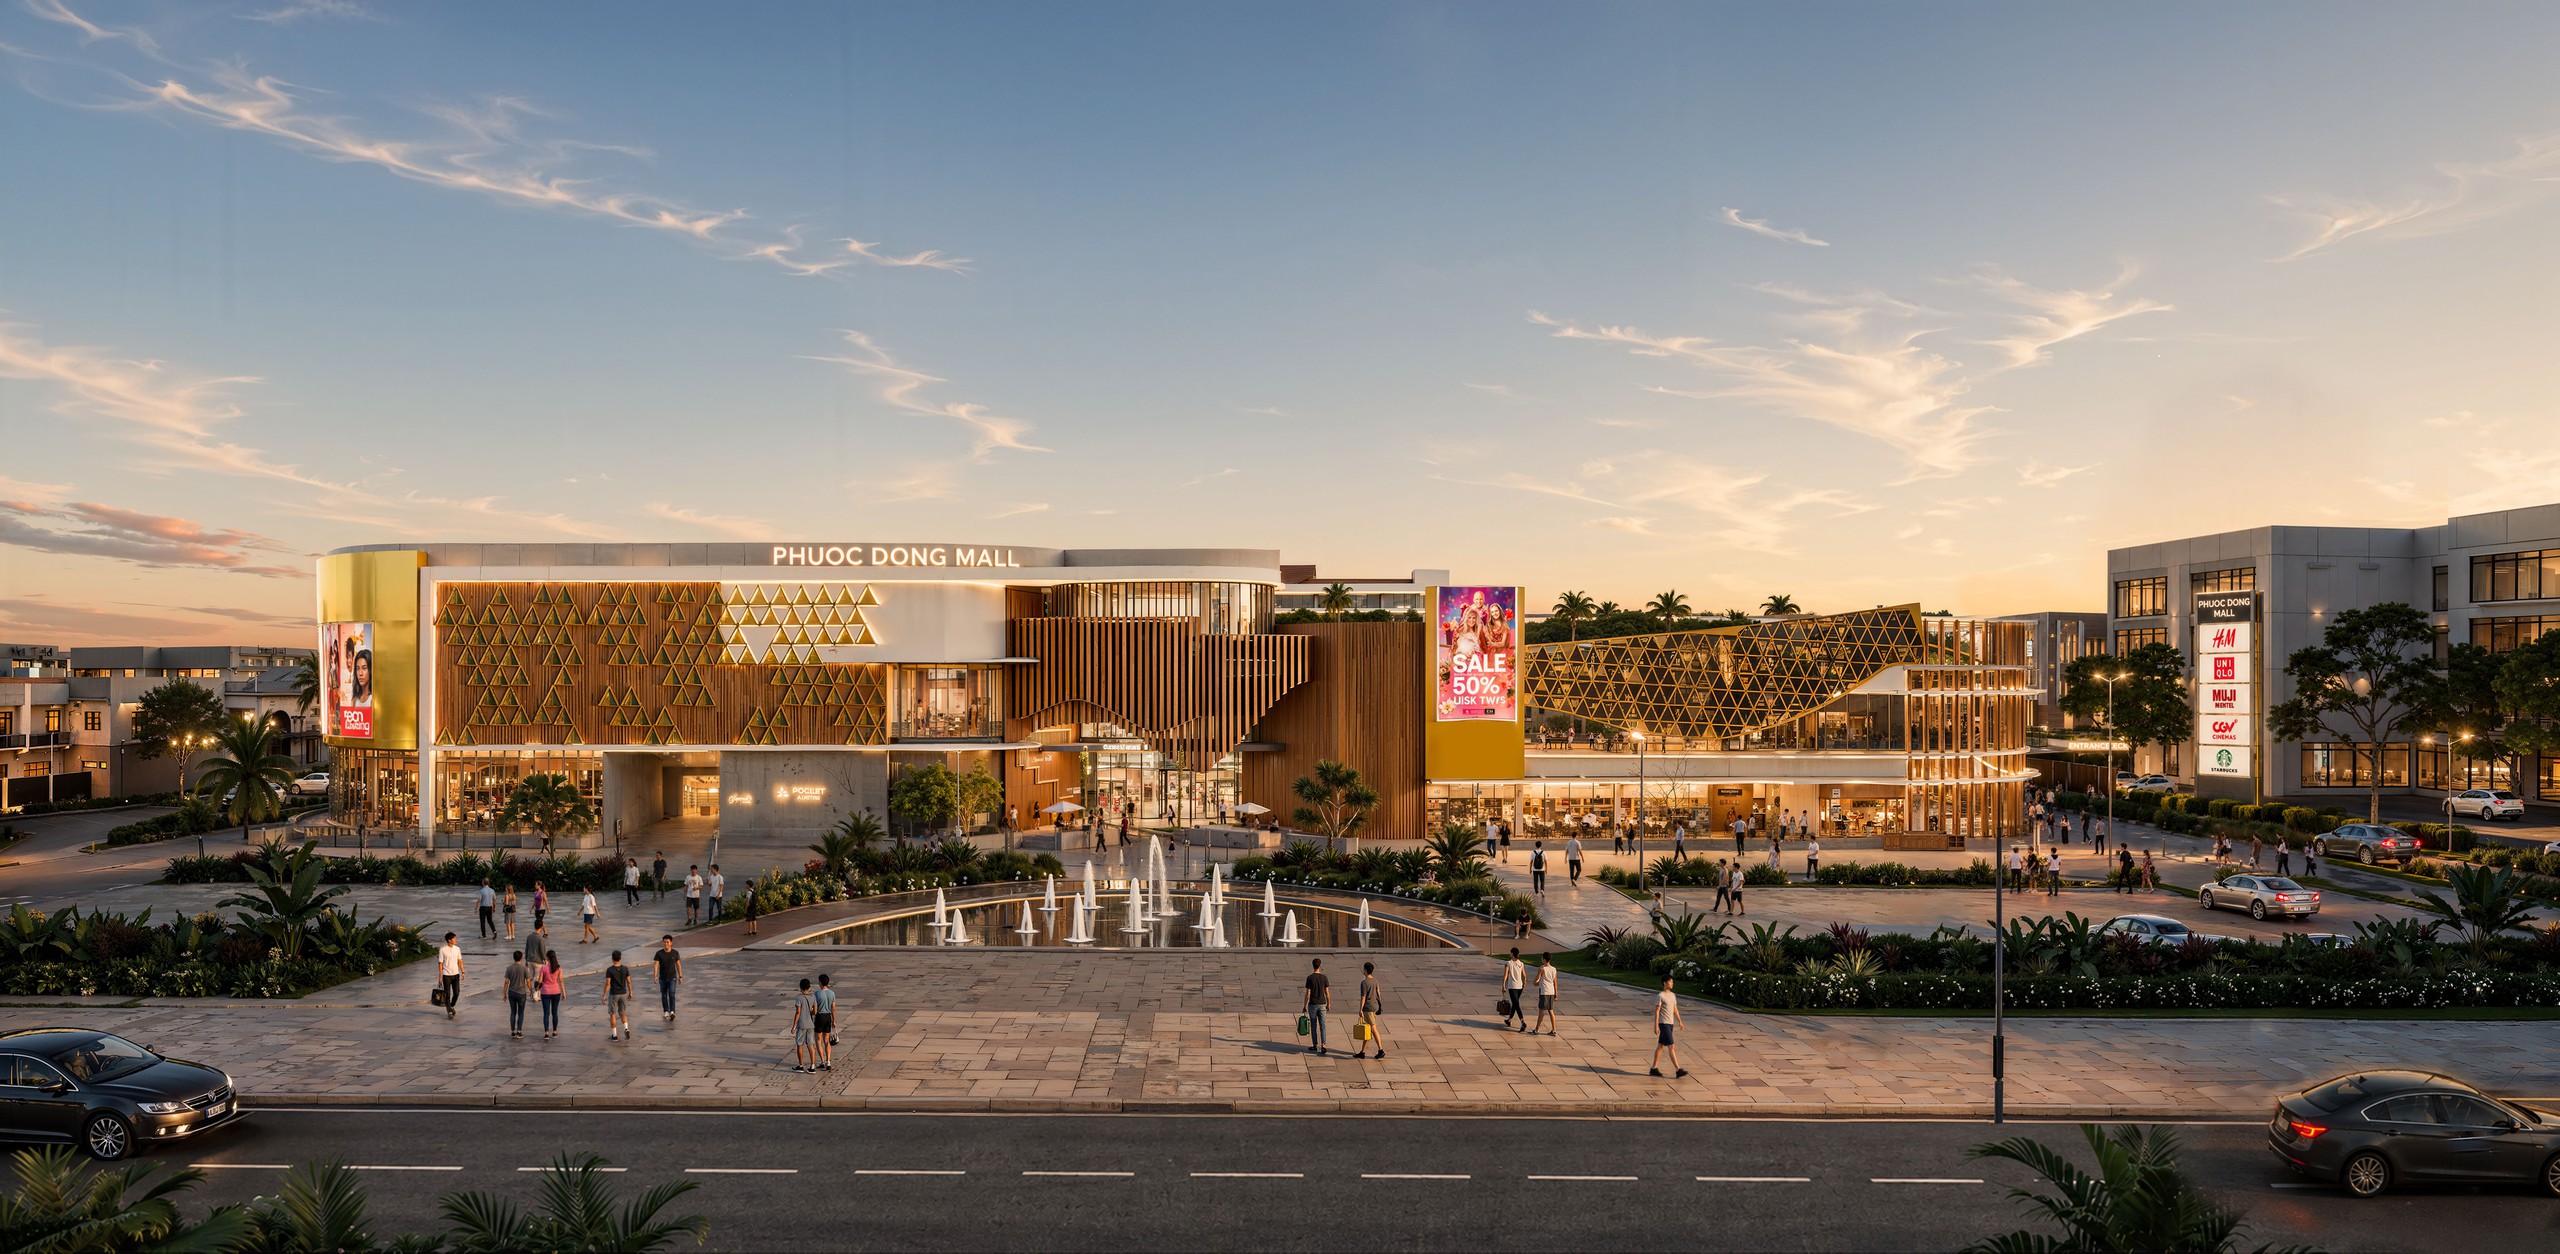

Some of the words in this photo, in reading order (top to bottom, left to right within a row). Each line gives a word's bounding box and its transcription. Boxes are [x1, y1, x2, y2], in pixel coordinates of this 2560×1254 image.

[773, 547, 862, 565] PHUOC
[872, 547, 946, 565] DONG
[956, 548, 1019, 567] MALL
[2199, 600, 2225, 608] PHUOC
[2227, 598, 2250, 607] DONG
[2214, 609, 2235, 617] MALL
[2213, 628, 2236, 648] H&M
[1453, 654, 1506, 673] SALE
[2217, 669, 2232, 678] QLO
[1453, 676, 1500, 695] 50%
[2213, 689, 2236, 701] MUJI
[2212, 721, 2235, 733] CGV
